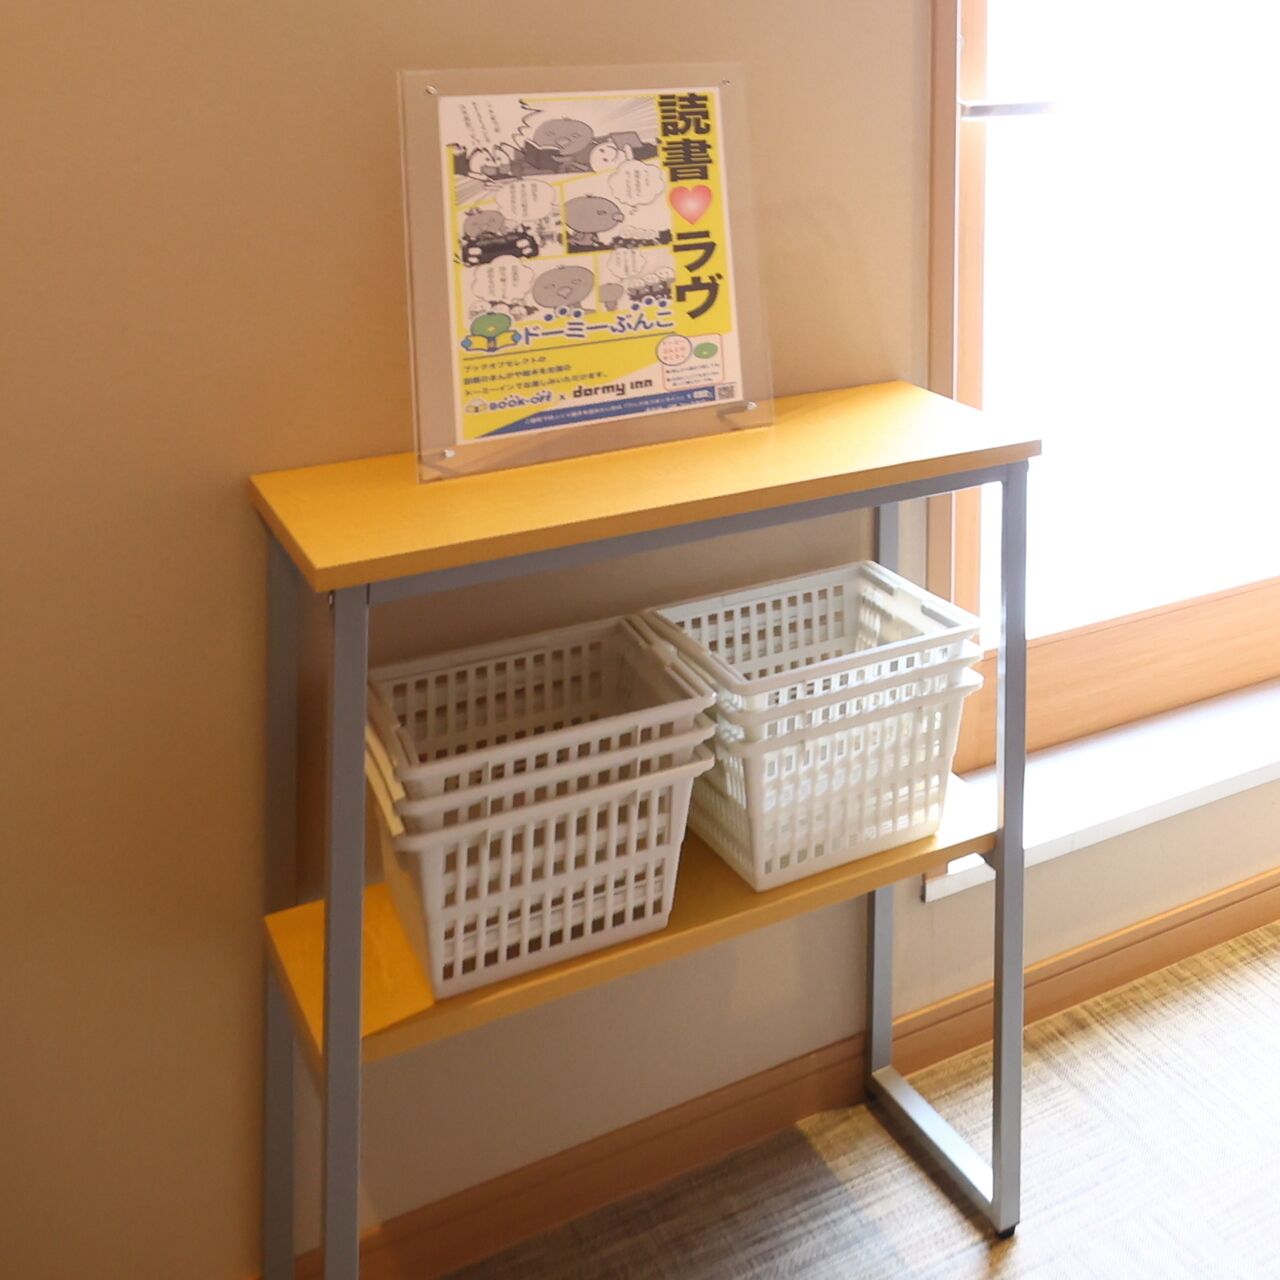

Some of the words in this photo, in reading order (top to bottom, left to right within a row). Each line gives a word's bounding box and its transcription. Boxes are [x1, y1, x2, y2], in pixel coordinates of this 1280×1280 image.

[658, 93, 711, 182] 読書
[673, 230, 723, 319] ラヴ
[522, 312, 674, 345] ドーミーぶんこ
[489, 391, 553, 410] BOOK-OFF
[573, 384, 625, 399] dormy
[630, 379, 653, 391] inn
